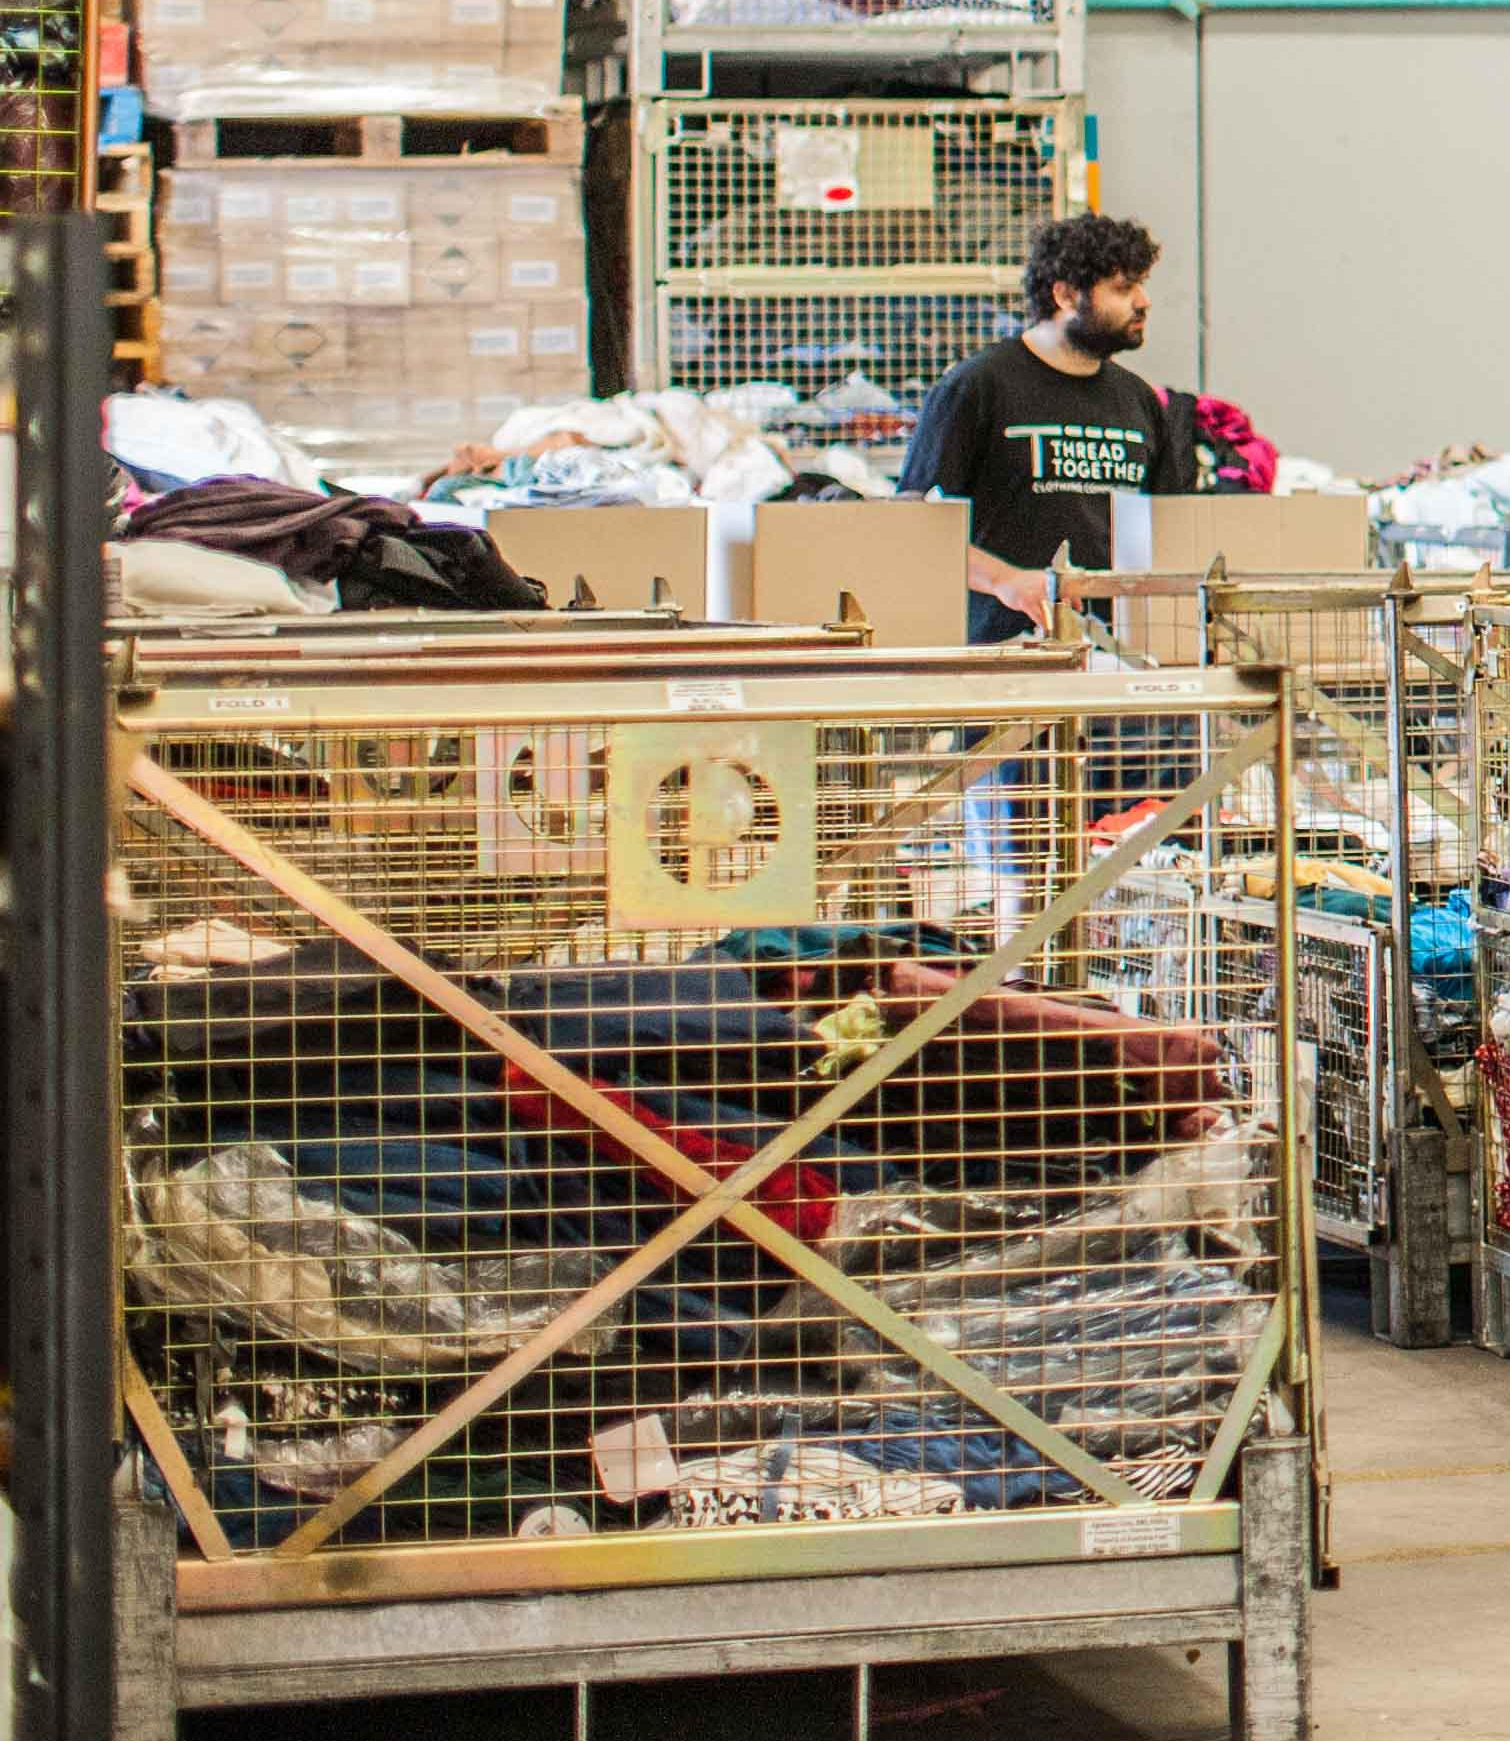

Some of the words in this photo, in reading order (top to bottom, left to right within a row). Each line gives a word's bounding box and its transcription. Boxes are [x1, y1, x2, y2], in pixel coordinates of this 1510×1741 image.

[1050, 439, 1126, 462] THREAD
[1051, 458, 1146, 483] TOGETHER
[1134, 683, 1179, 693] FOLD
[215, 699, 265, 708] FOLD
